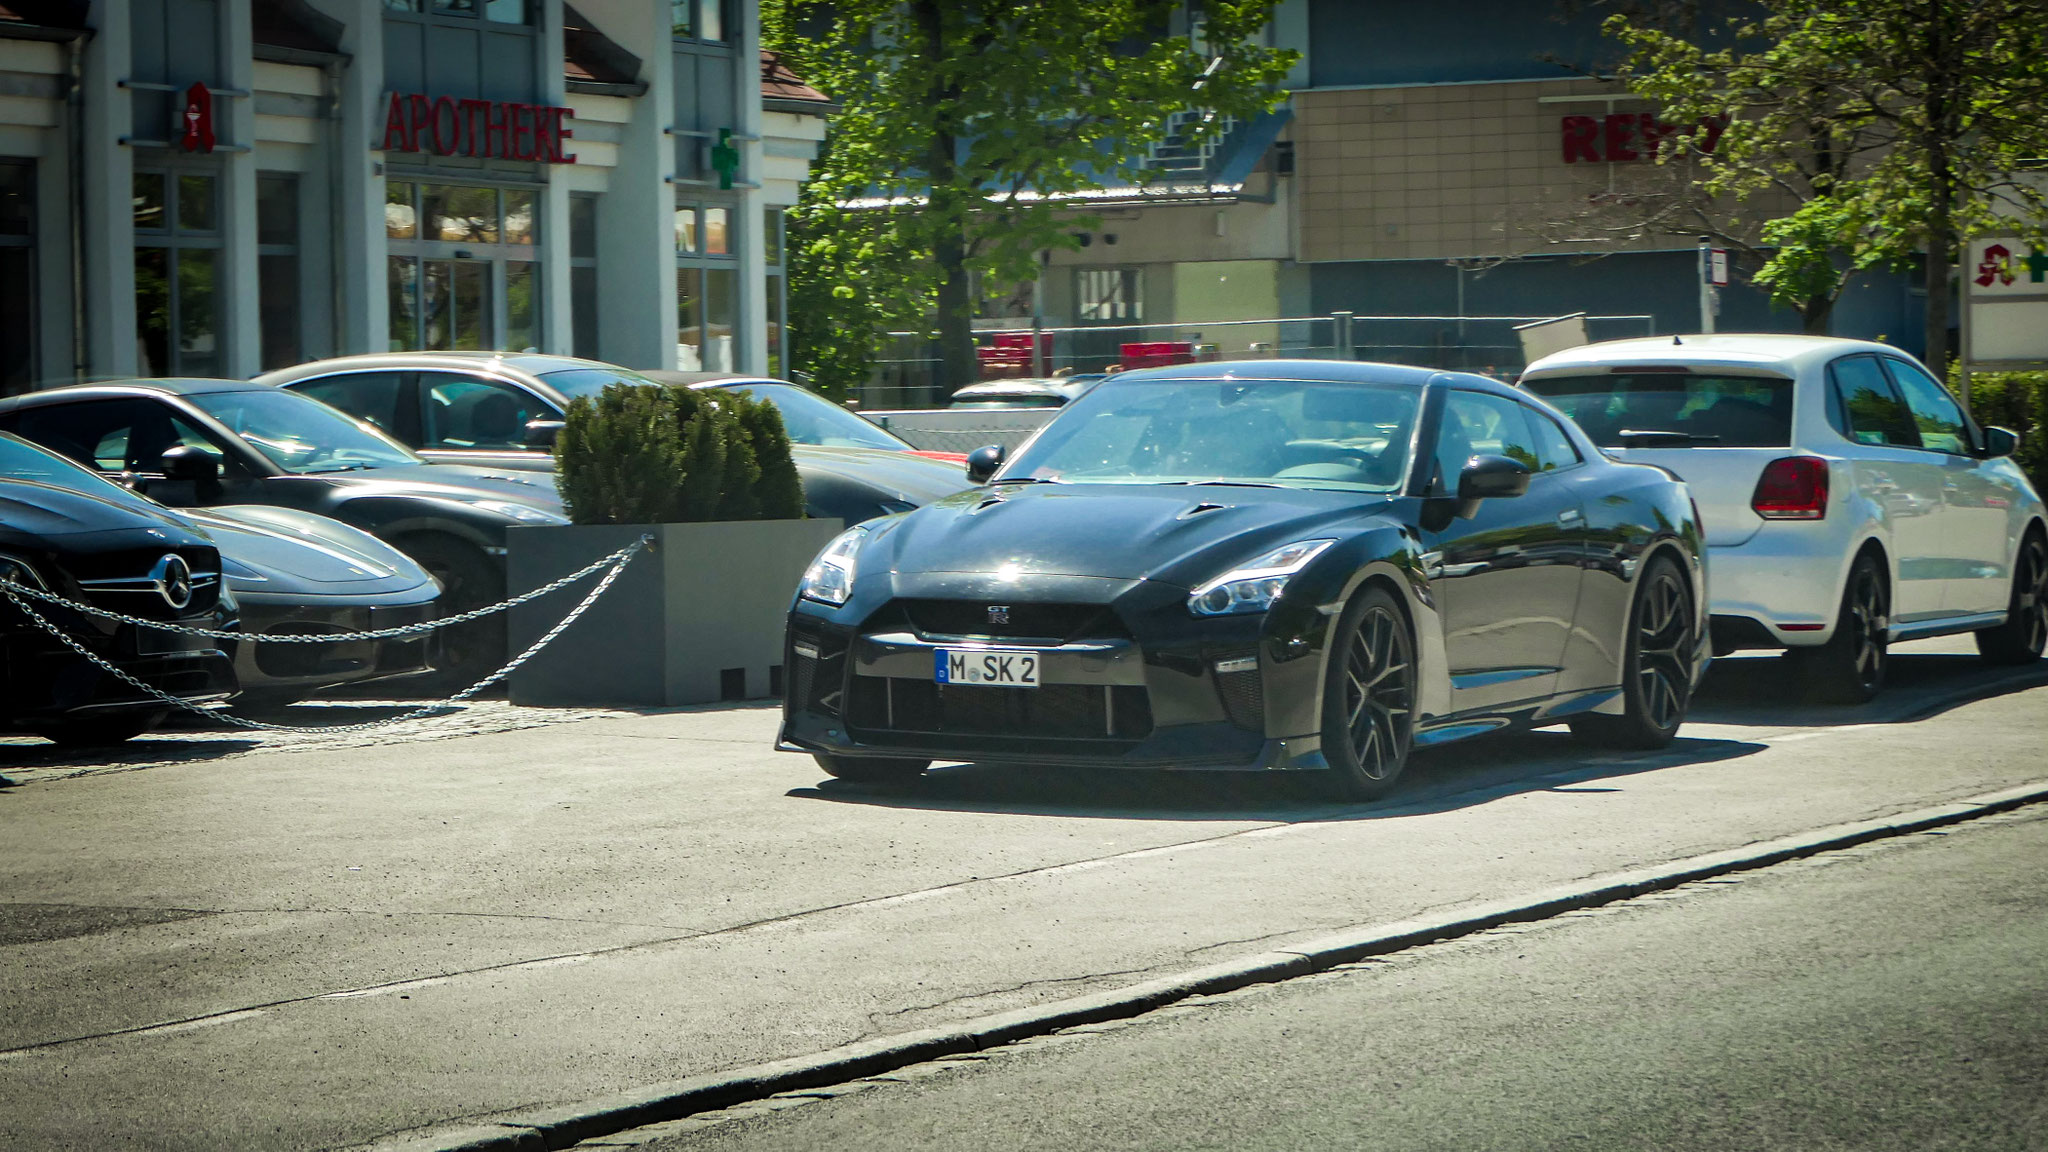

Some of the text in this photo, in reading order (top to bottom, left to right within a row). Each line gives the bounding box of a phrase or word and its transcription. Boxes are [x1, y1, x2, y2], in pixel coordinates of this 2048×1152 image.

[384, 91, 577, 164] APOTHEKE
[949, 654, 1035, 683] M SK 2
